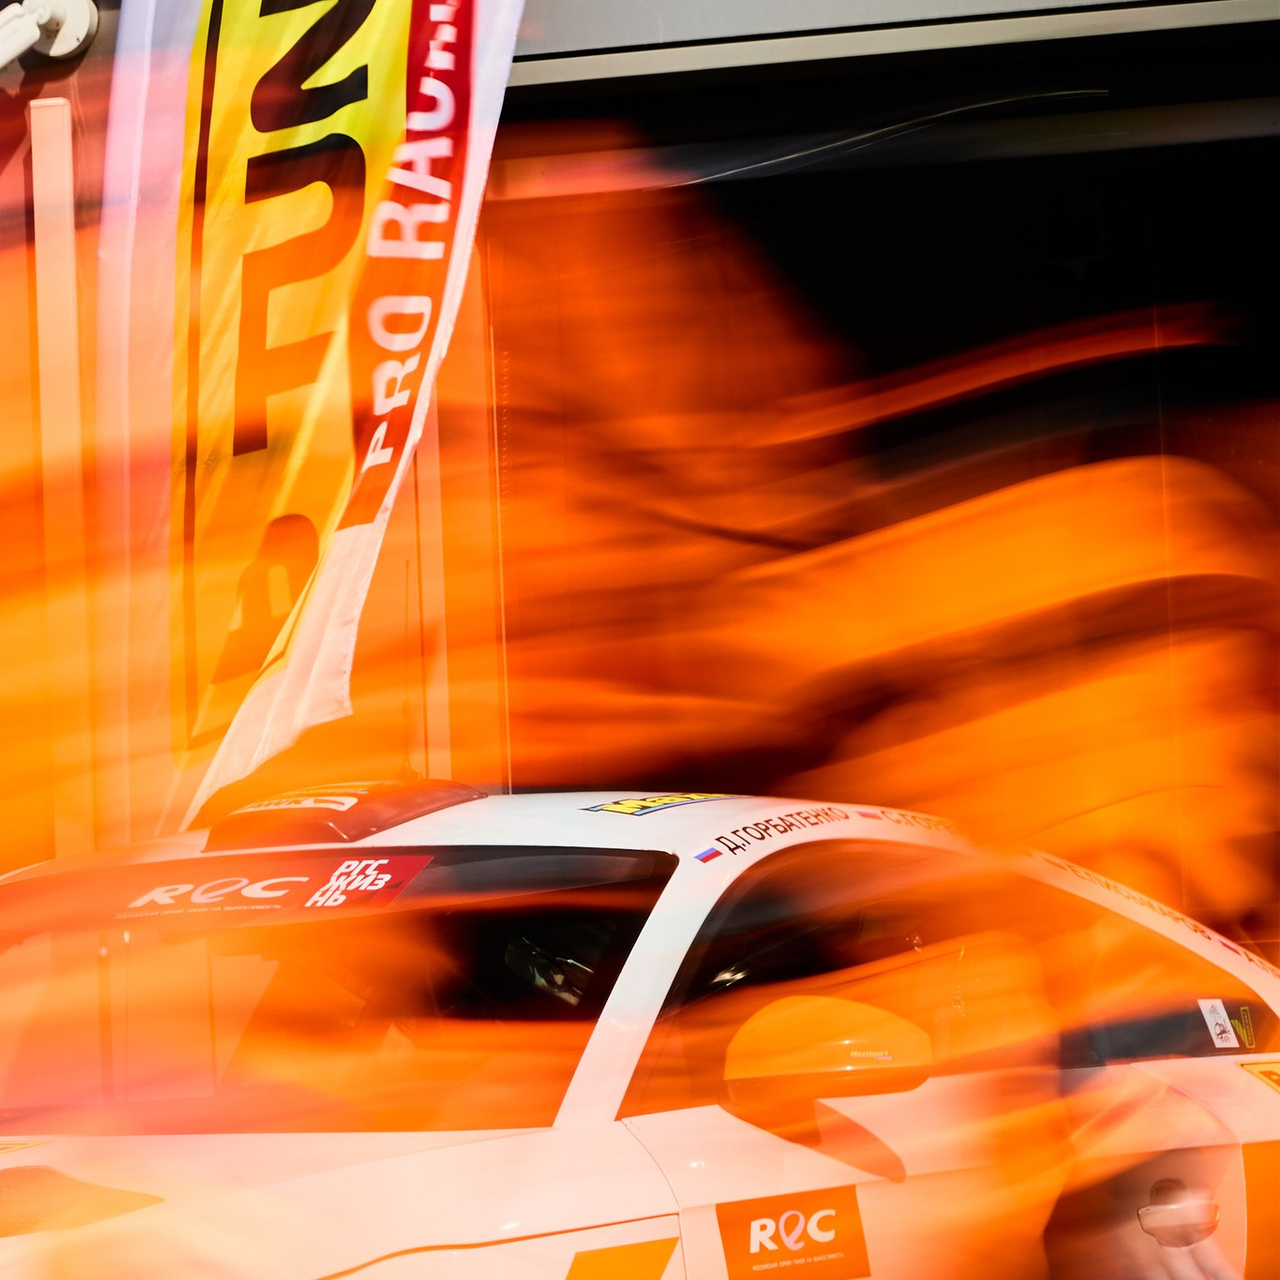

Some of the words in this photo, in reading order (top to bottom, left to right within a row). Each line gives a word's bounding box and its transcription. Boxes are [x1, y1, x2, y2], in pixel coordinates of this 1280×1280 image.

[361, 294, 432, 474] PRO
[714, 806, 851, 856] Д.ГОРБАТЕНКО
[332, 859, 390, 876] РГС
[320, 873, 392, 891] ЖИЗ
[304, 890, 347, 907] НЬ
